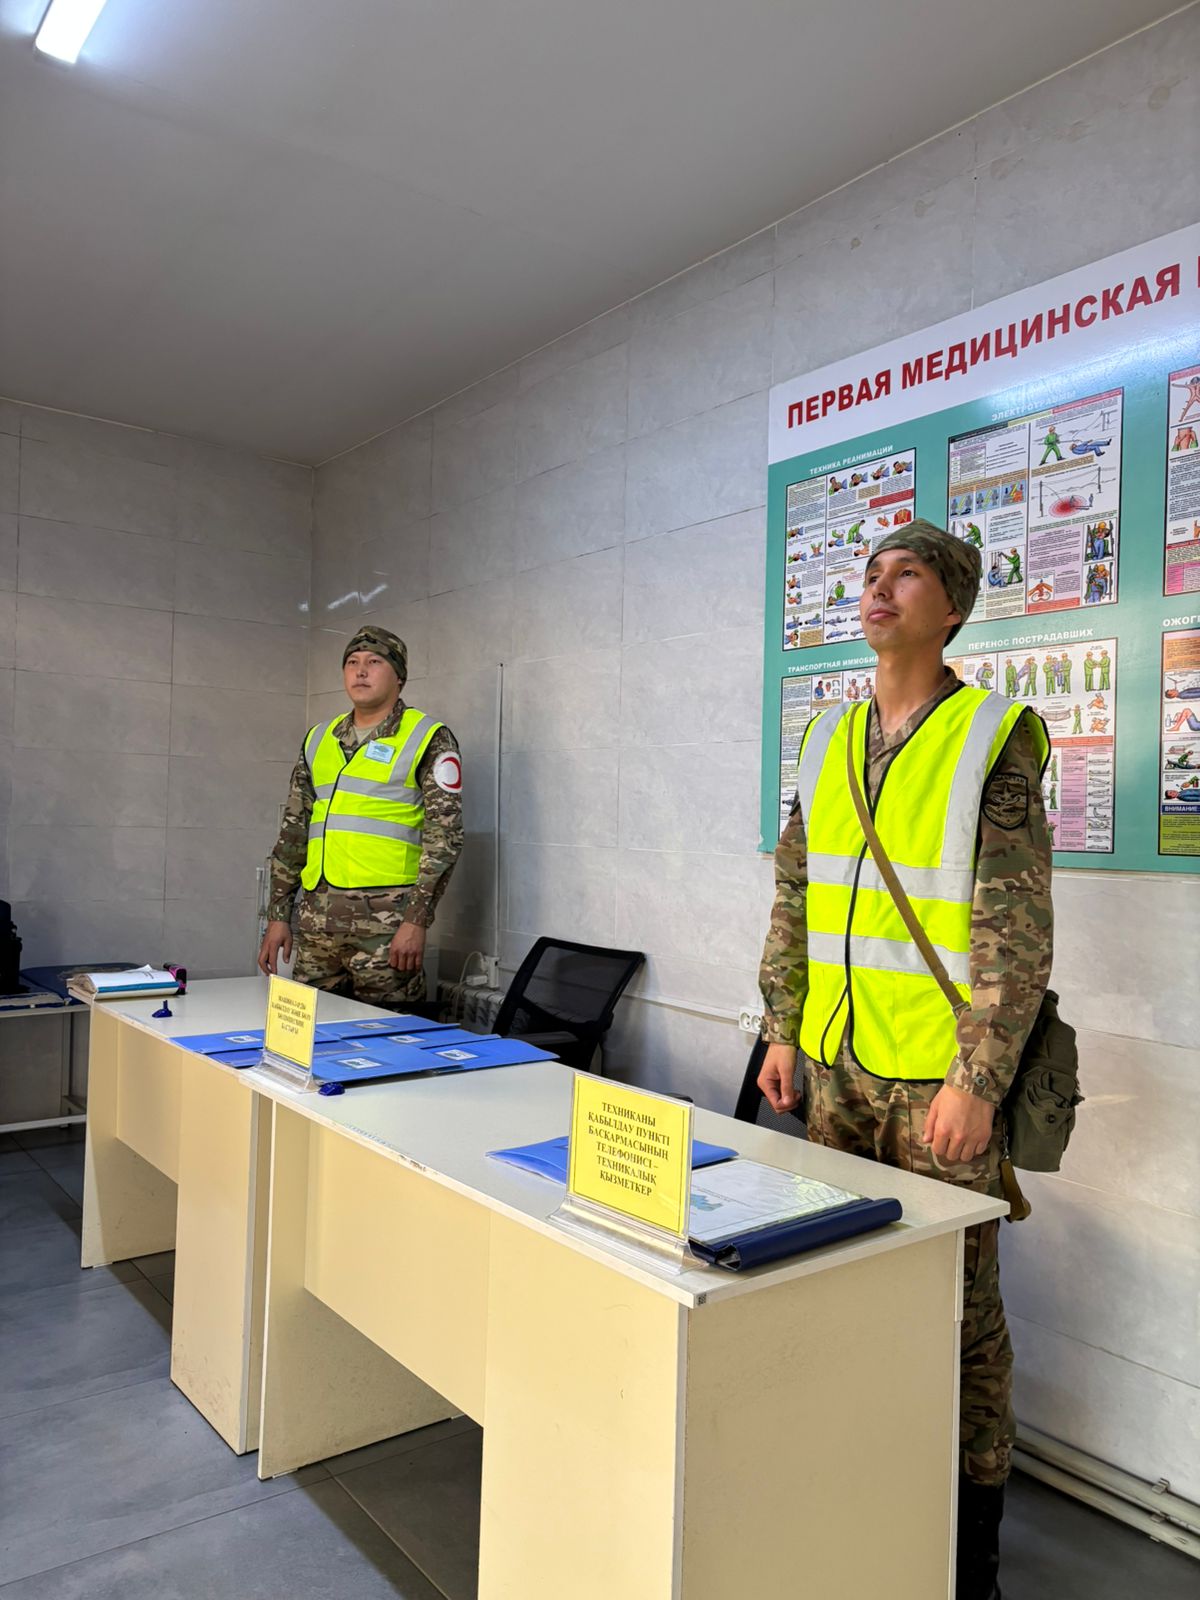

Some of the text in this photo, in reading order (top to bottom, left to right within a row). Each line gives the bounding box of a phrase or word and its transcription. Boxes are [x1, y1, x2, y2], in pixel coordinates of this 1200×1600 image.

[787, 263, 1180, 429] ПЕРВАЯ МЕДИЦИНСКАЯ
[809, 445, 894, 475] ТЕХНИКА РЕАНИМАЦИИ
[1162, 615, 1200, 627] ОЖОГ
[968, 628, 1094, 651] ПЕРЕНОС ПОСТРАДАВШИХ
[788, 661, 841, 673] ТРАНСПОРТНАЯ
[602, 1102, 656, 1127] ТЕХНИКАНЫ
[636, 1127, 670, 1146] ПУНКТІ
